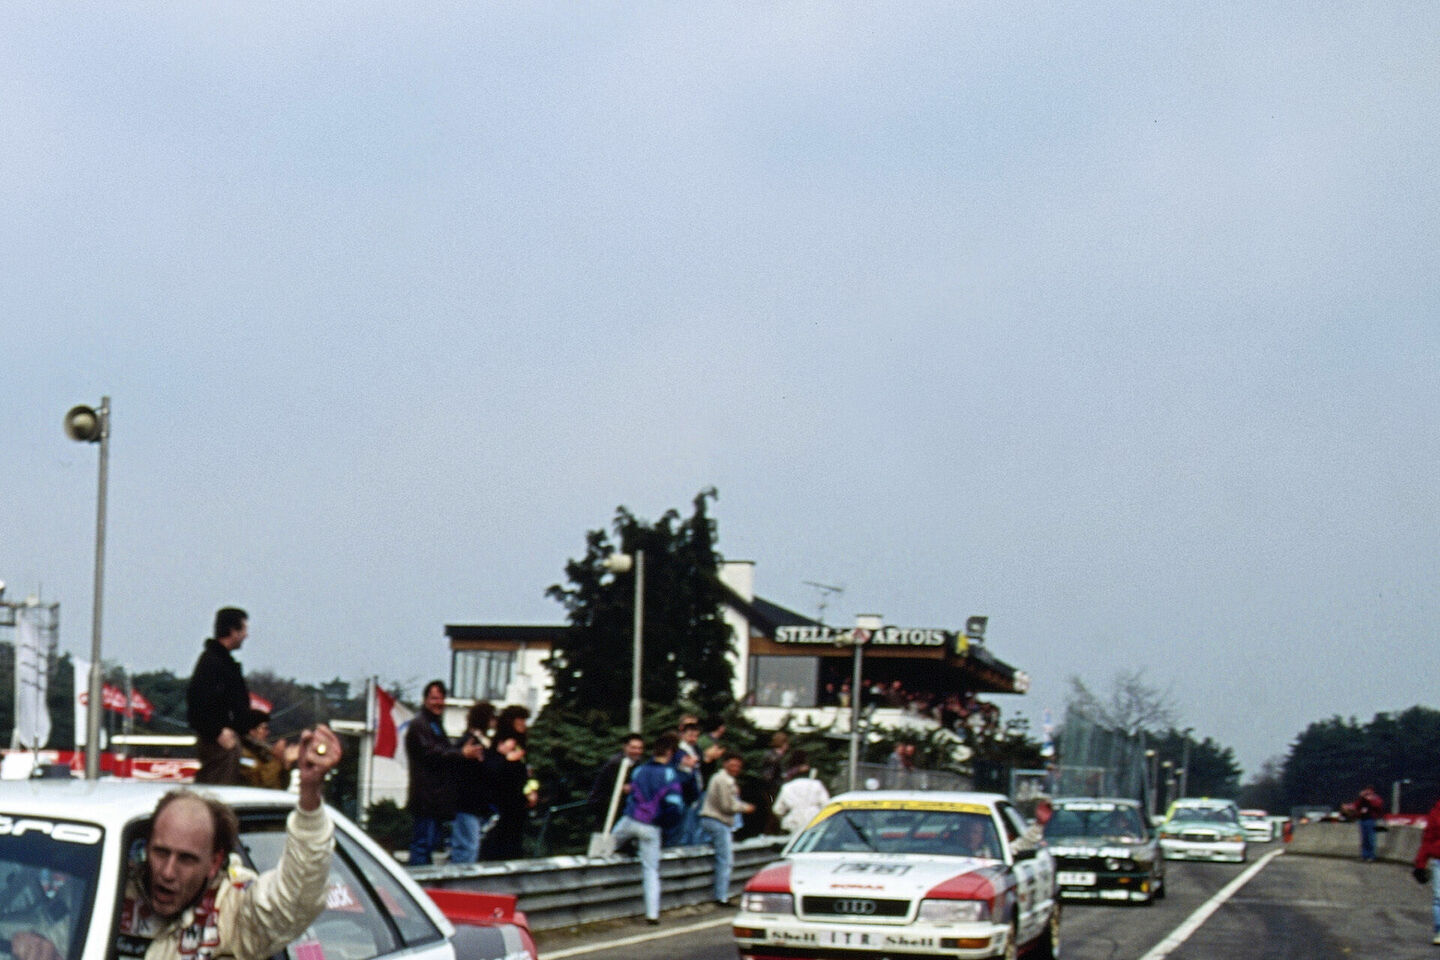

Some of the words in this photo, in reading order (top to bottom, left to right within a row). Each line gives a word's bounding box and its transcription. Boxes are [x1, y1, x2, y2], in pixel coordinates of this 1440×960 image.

[775, 626, 846, 644] STELL
[872, 629, 946, 646] ARTOIS
[771, 930, 817, 942] Shell
[885, 936, 934, 947] Shell
